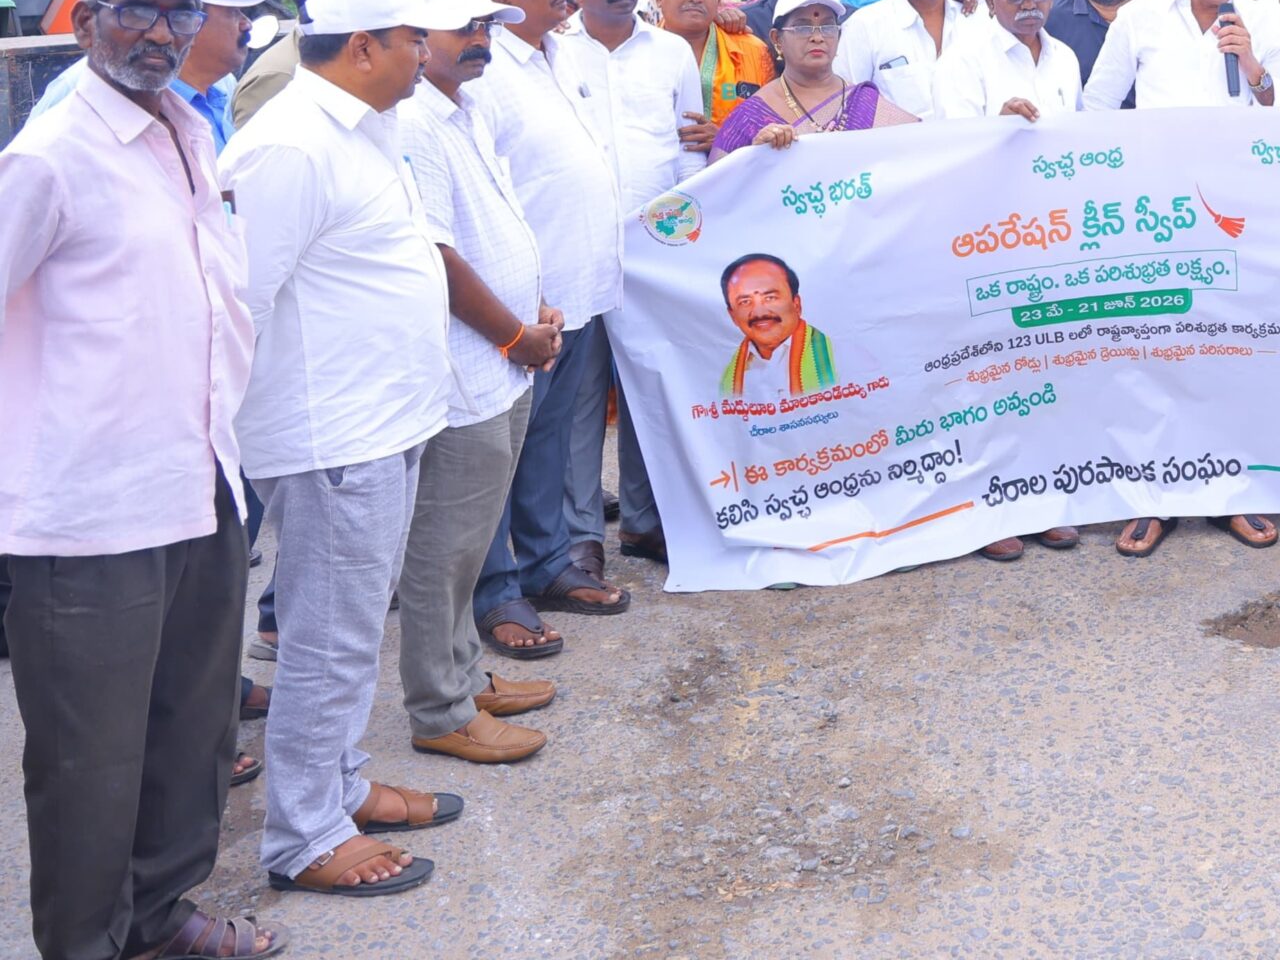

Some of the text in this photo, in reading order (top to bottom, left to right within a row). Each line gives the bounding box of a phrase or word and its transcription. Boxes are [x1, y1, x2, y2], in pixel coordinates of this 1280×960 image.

[1079, 146, 1125, 169] ఆంధ్ర
[951, 195, 1197, 258] ఆపరేషన్ క్లీన్ స్వీప్
[976, 282, 1002, 302] ఒక
[1065, 268, 1091, 287] ఒక
[1095, 259, 1171, 284] పరిశుభ్రత
[1020, 310, 1043, 322] 23
[1046, 306, 1064, 318] మే
[1078, 302, 1099, 314] 21
[1103, 296, 1136, 311] జూన్
[1140, 294, 1185, 308] 2026
[1007, 336, 1032, 350] 123
[1035, 331, 1065, 345] ULB
[1068, 324, 1093, 341] లలో
[1175, 321, 1228, 337] పరిశుభ్రత
[1052, 349, 1097, 367] శుభ్రమైన
[1151, 344, 1196, 361] శుభ్రమైన
[1199, 344, 1253, 356] పరిసరాలు
[744, 382, 1058, 485] ఈ కార్యక్రమంలో మీరు భాగం అవ్వండి
[749, 425, 777, 438] చీరాల
[981, 453, 1242, 507] చీరాల పురపాలక సంఘం
[716, 500, 759, 530] కలిసి
[814, 470, 882, 499] ఆంధ్రను
